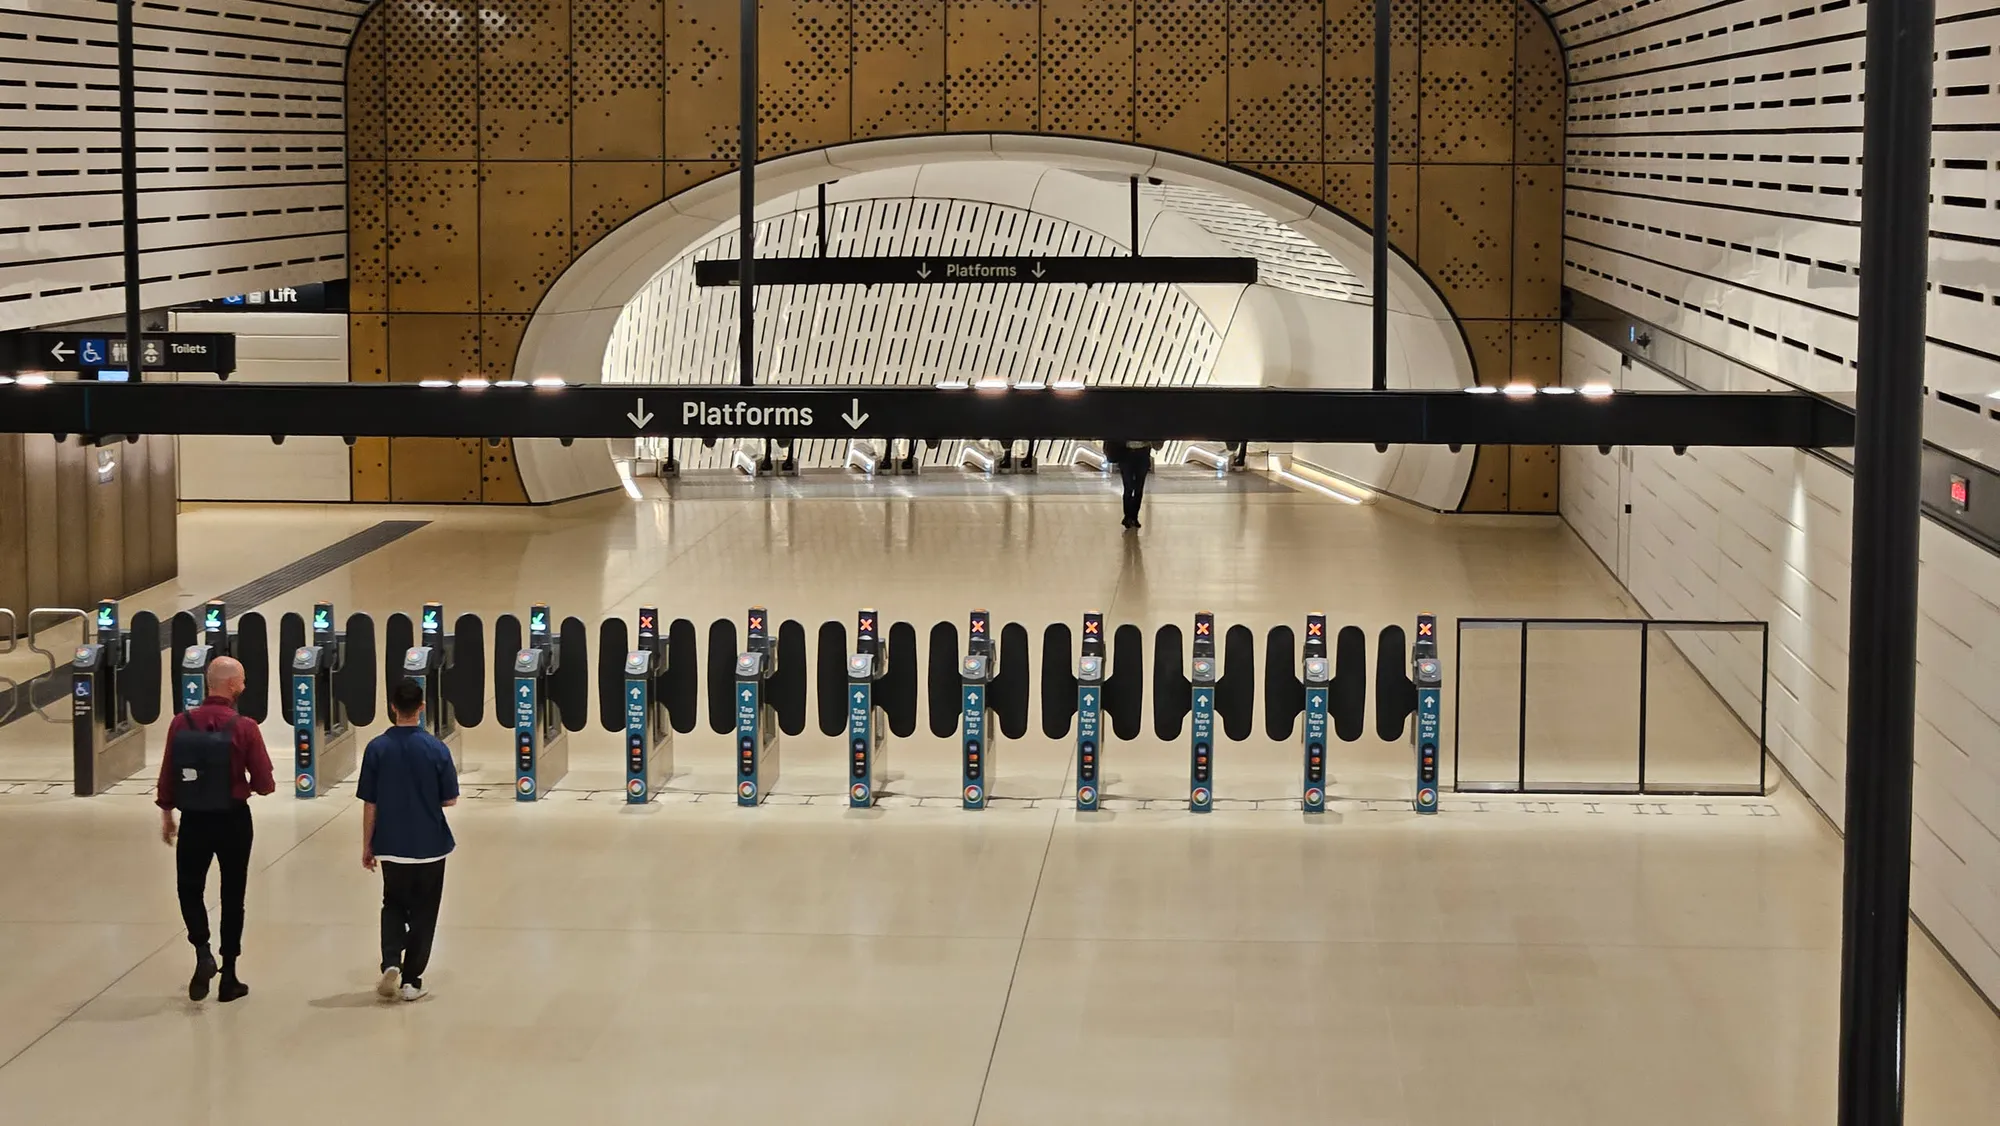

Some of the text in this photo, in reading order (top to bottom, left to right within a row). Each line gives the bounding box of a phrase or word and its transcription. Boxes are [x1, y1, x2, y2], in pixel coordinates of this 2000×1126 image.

[945, 264, 1017, 277] Platforms
[269, 287, 298, 302] Lift
[170, 343, 207, 354] Toilets
[682, 401, 814, 426] Platforms
